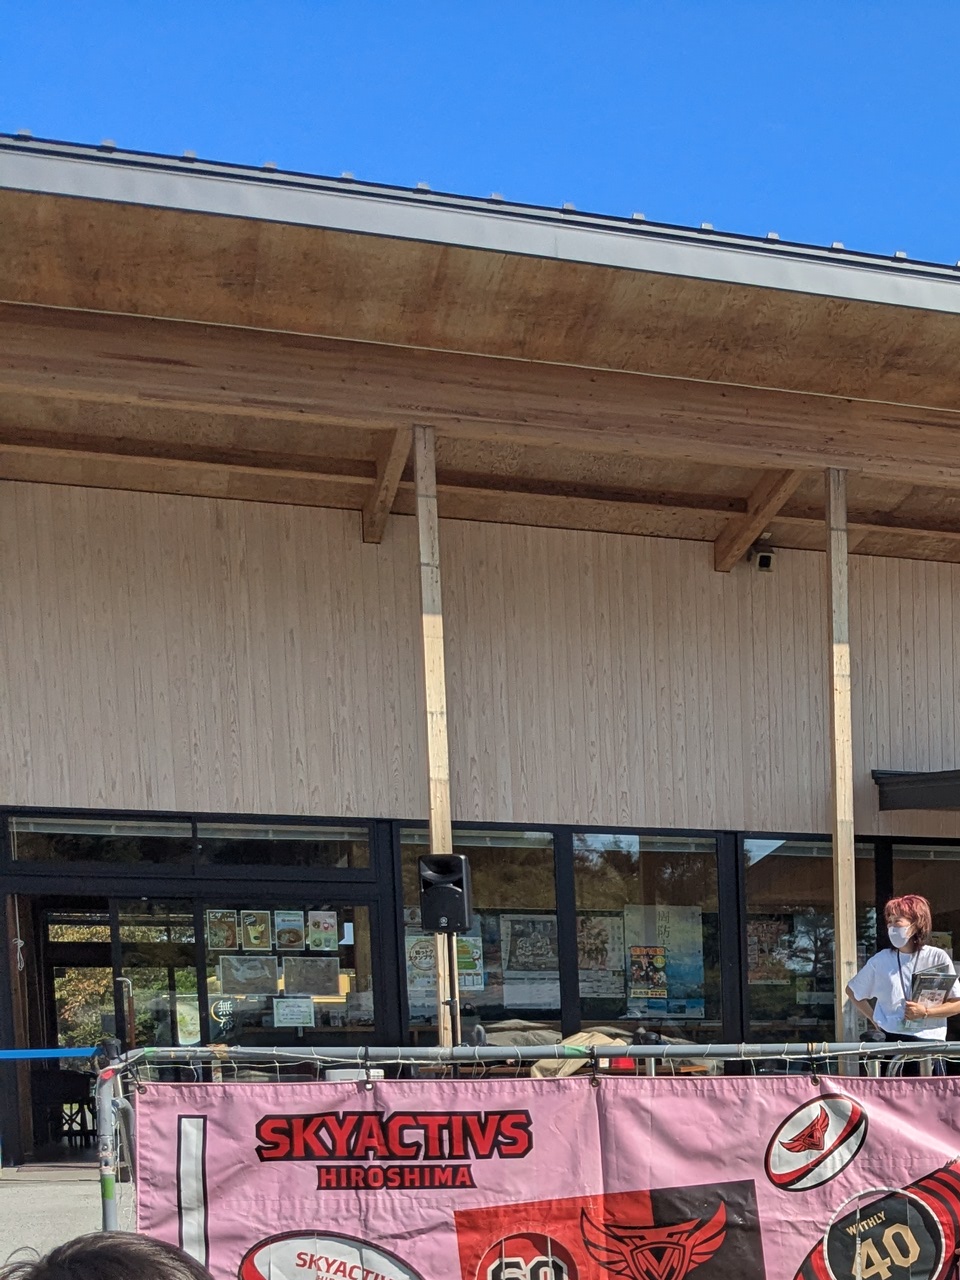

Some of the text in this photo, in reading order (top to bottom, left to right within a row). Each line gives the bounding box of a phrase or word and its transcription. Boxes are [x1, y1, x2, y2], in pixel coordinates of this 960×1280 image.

[255, 1110, 534, 1162] SKYACTIVS
[316, 1164, 478, 1190] HIROSHIMA
[846, 1211, 886, 1236] WITHLY
[851, 1223, 921, 1280] 40
